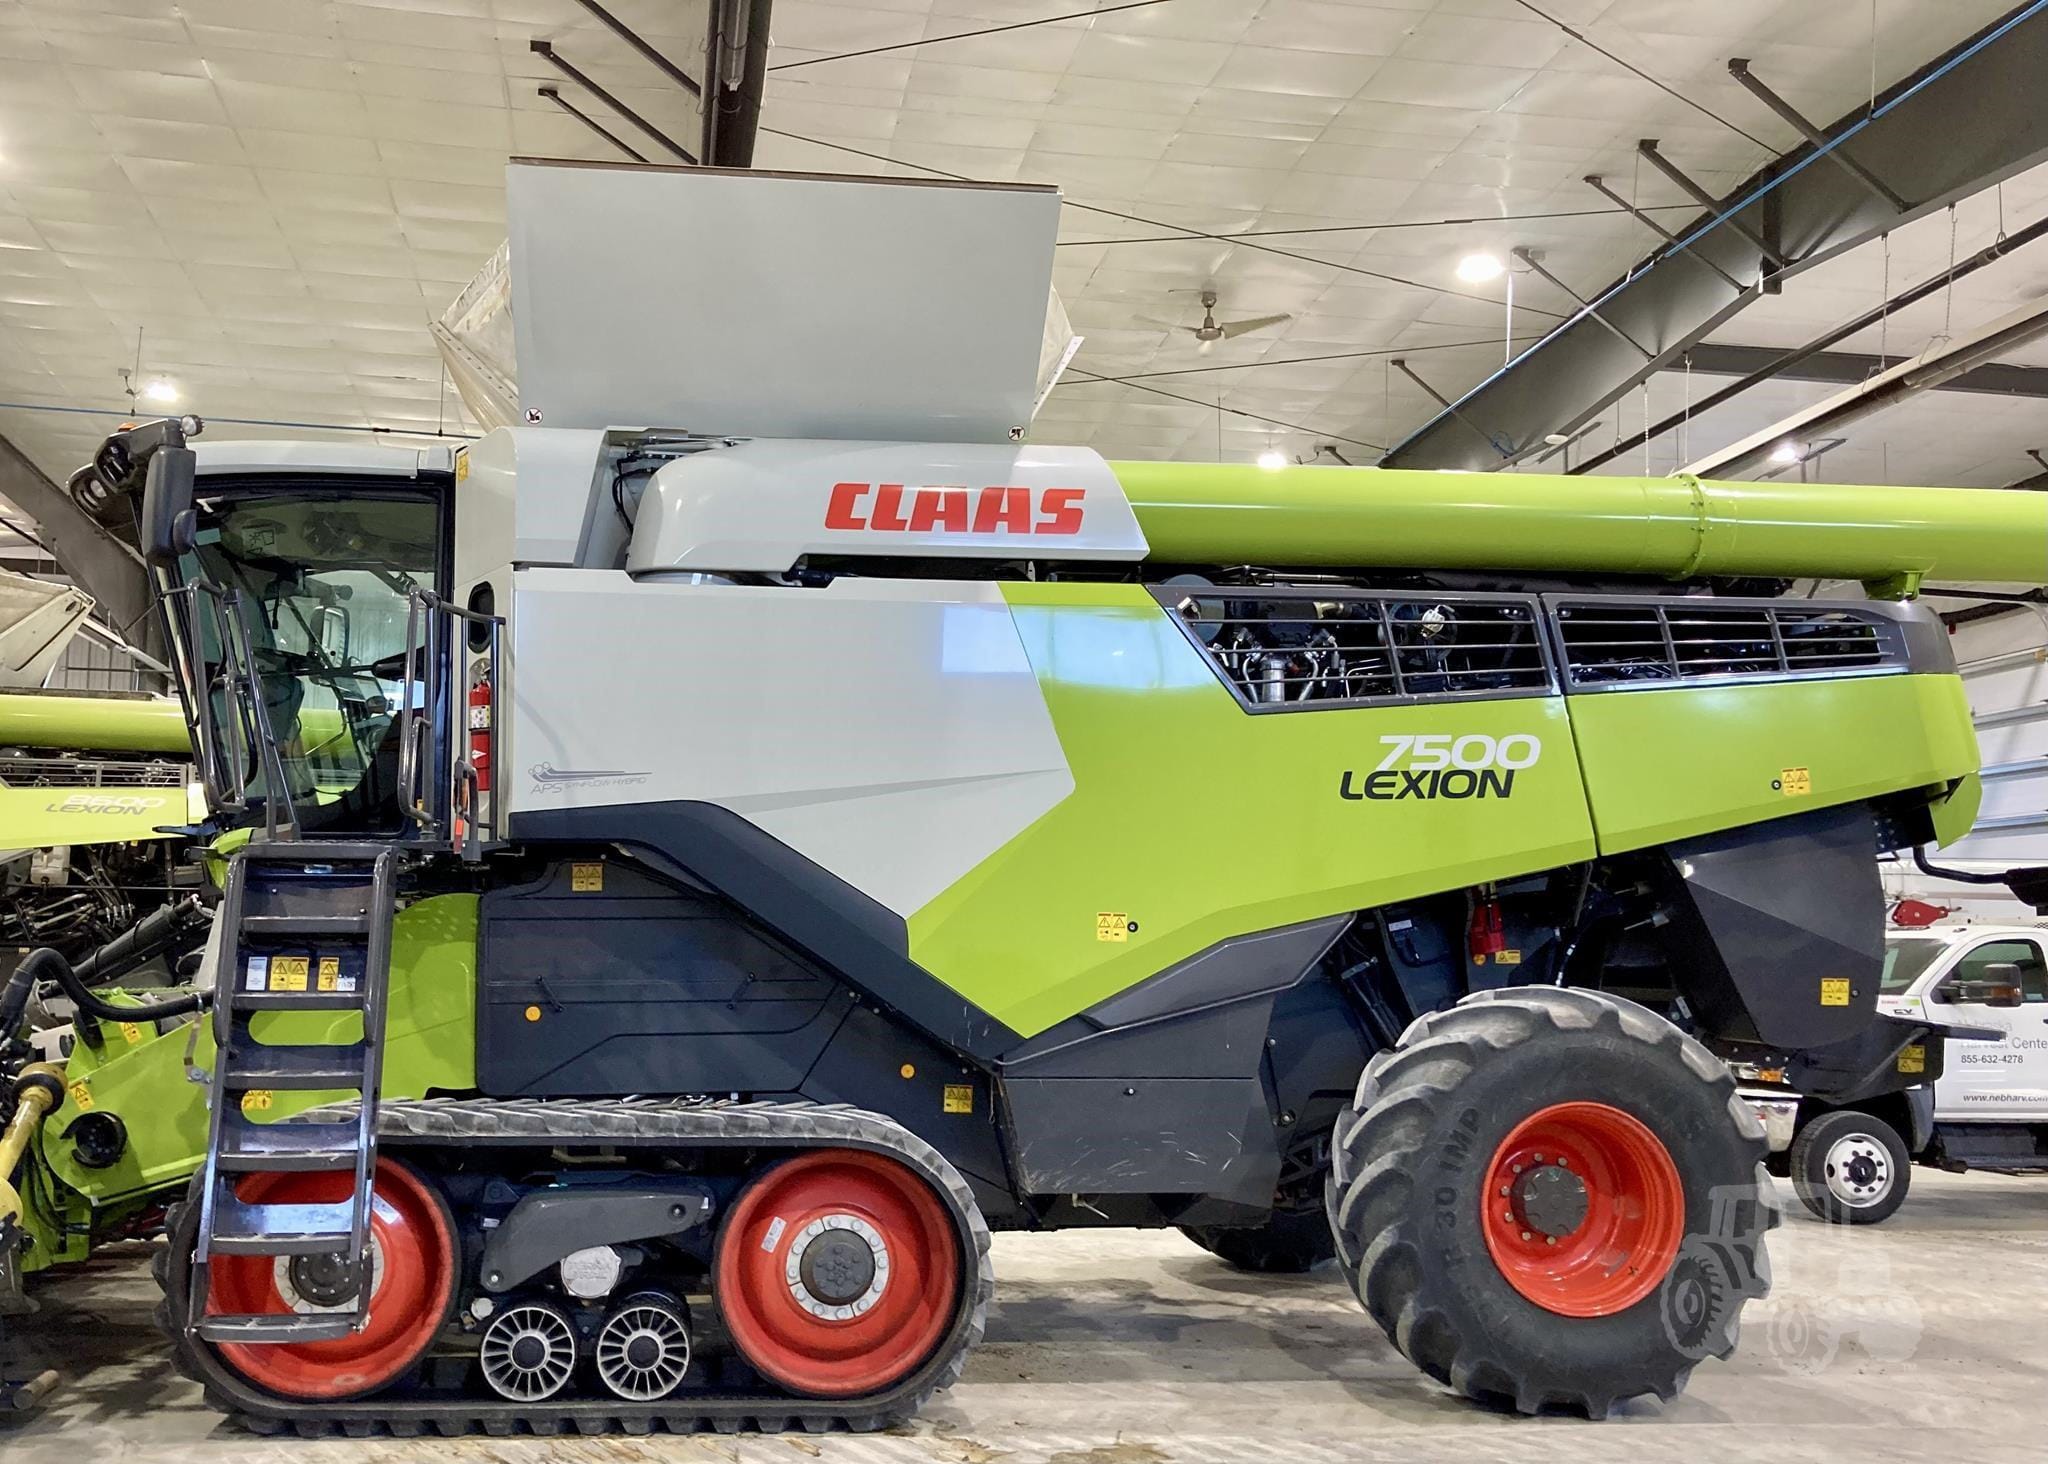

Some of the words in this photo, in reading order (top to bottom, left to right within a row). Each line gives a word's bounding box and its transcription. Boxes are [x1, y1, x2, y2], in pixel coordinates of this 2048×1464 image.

[825, 483, 1085, 535] CLAAS
[1376, 734, 1541, 771] 7500
[531, 782, 563, 794] APS
[1340, 769, 1515, 800] LEXION
[64, 794, 167, 808] 8600
[45, 803, 147, 815] LEXION
[1961, 1055, 2024, 1064] 855-632-4278
